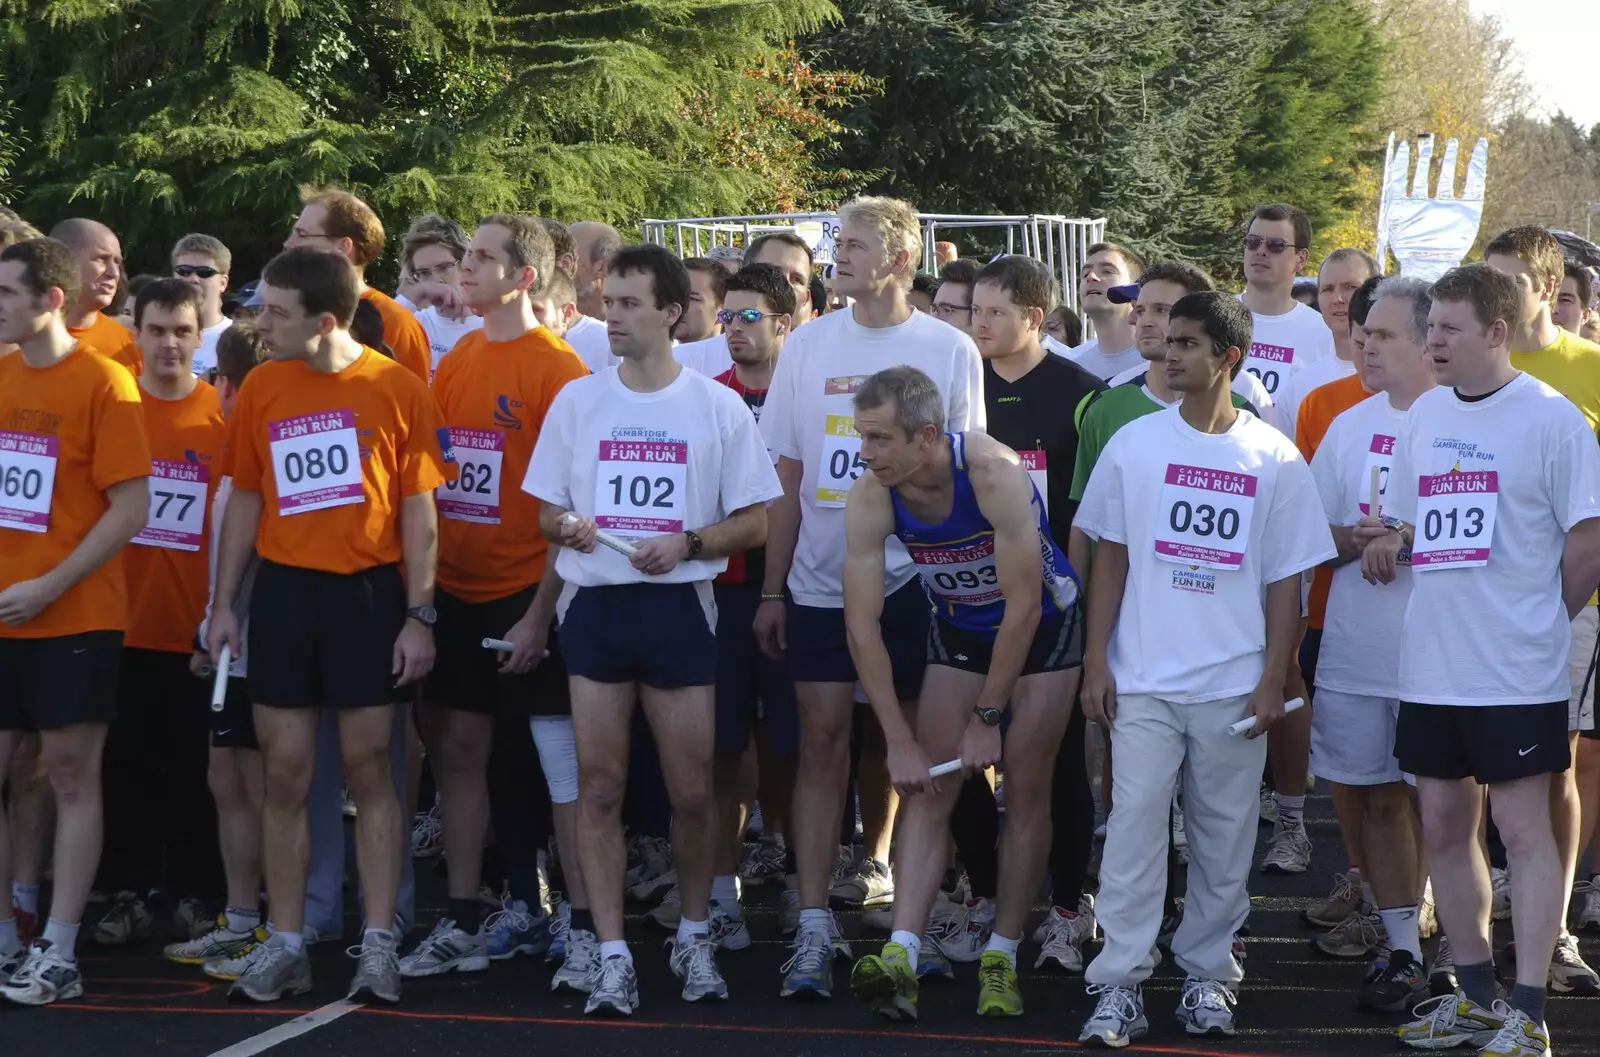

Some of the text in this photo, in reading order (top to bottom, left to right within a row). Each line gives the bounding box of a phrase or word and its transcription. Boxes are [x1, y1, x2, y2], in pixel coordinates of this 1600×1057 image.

[1259, 350, 1285, 361] RUN
[279, 412, 343, 427] CAMBRIDGE
[280, 423, 308, 439] FUN
[312, 418, 344, 433] RUN
[611, 430, 668, 438] CAMBRIDGE
[18, 440, 48, 455] RUN
[450, 435, 496, 449] FUN RUN
[611, 443, 677, 451] CAMBRIDGE
[1432, 441, 1478, 451] CAMBRIDGE
[610, 449, 677, 462] FUN RUN
[1458, 450, 1495, 461] FUN RUN
[284, 444, 350, 484] 080
[169, 468, 199, 481] RUN
[1179, 467, 1246, 483] CAMBRIDGE
[1431, 475, 1488, 484] CAMBRIDGE
[1177, 473, 1245, 494] FUN RUN
[1430, 481, 1487, 495] FUN RUN
[608, 475, 675, 508] 102
[1169, 500, 1240, 541] 030
[1424, 507, 1485, 542] 013
[924, 550, 989, 564] FUN RUN
[1177, 550, 1194, 558] Raise
[1199, 553, 1220, 562] Smile!
[1180, 545, 1208, 554] CHILDREN
[1215, 550, 1231, 558] NEED
[934, 564, 998, 590] 093
[1172, 570, 1216, 582] CAMBRIDGE
[1172, 577, 1215, 591] FUN RUN
